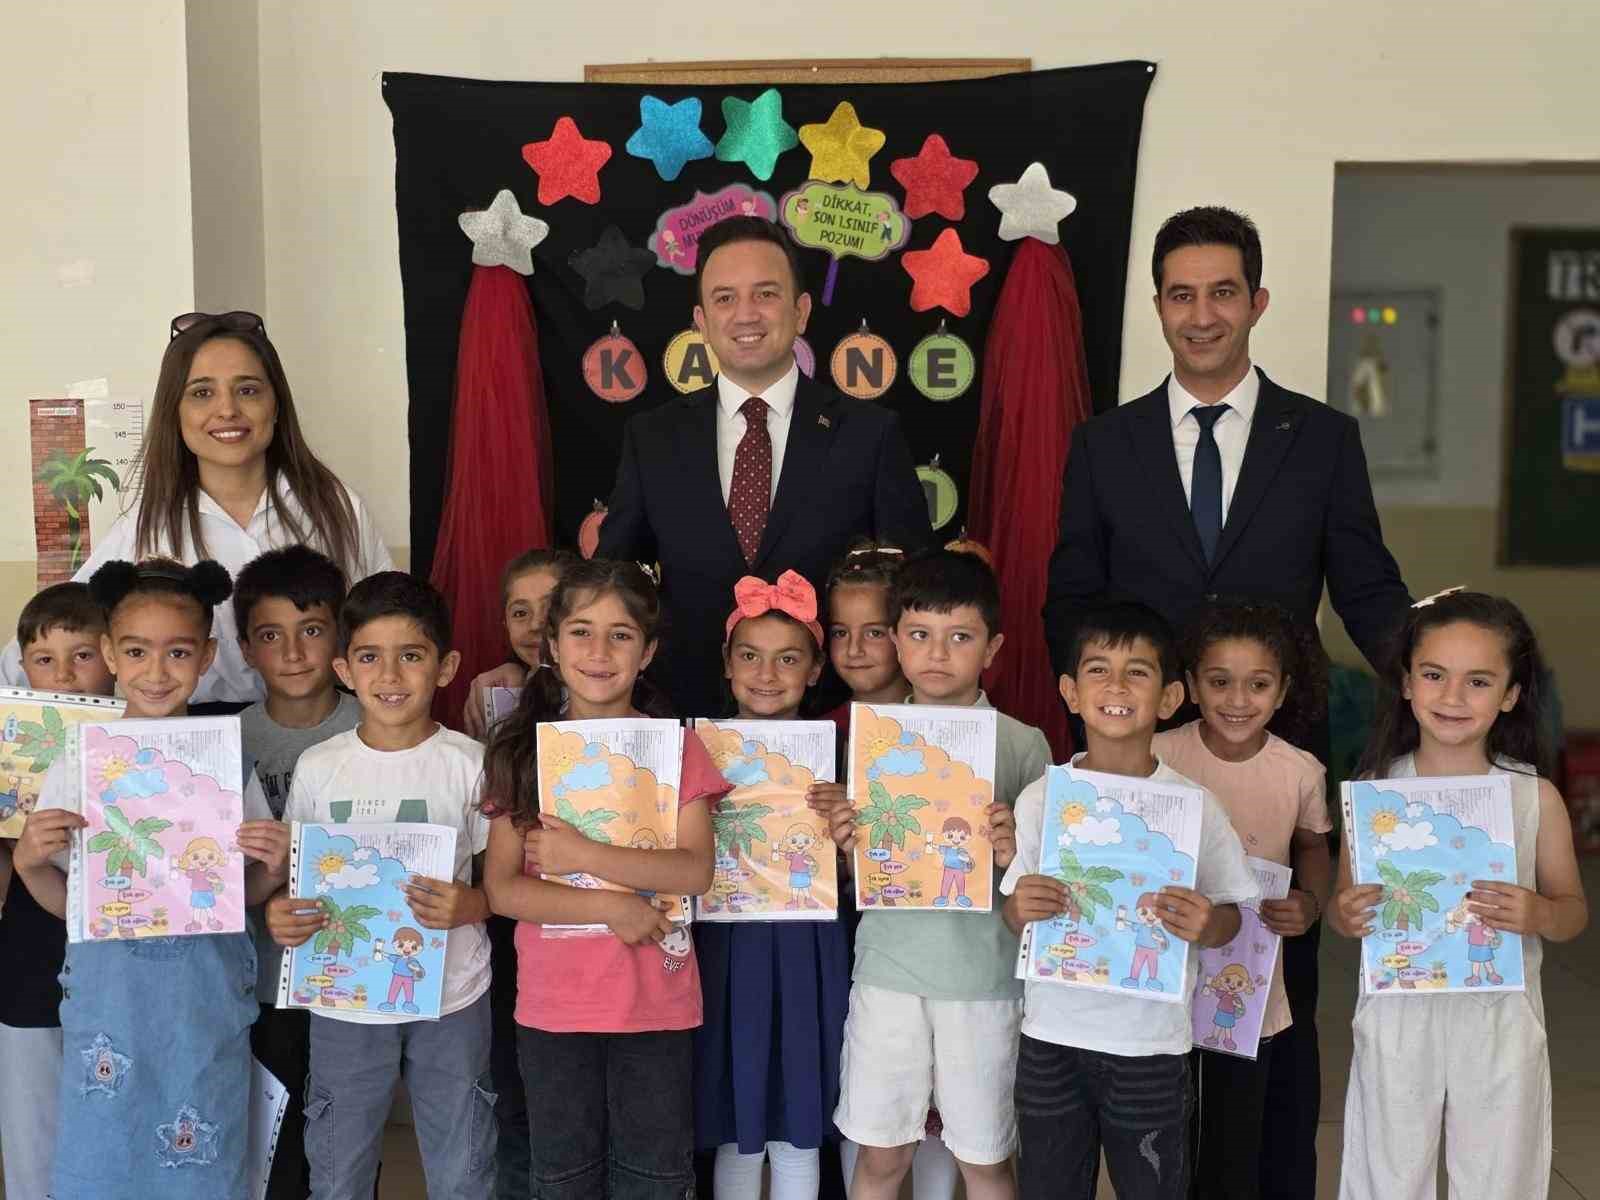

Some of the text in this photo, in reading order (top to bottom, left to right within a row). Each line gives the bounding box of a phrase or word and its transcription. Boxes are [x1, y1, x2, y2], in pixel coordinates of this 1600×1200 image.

[822, 194, 872, 217] DİKKAT,
[813, 211, 835, 226] SON
[112, 402, 126, 410] 150
[115, 430, 127, 439] 145
[115, 458, 129, 466] 140
